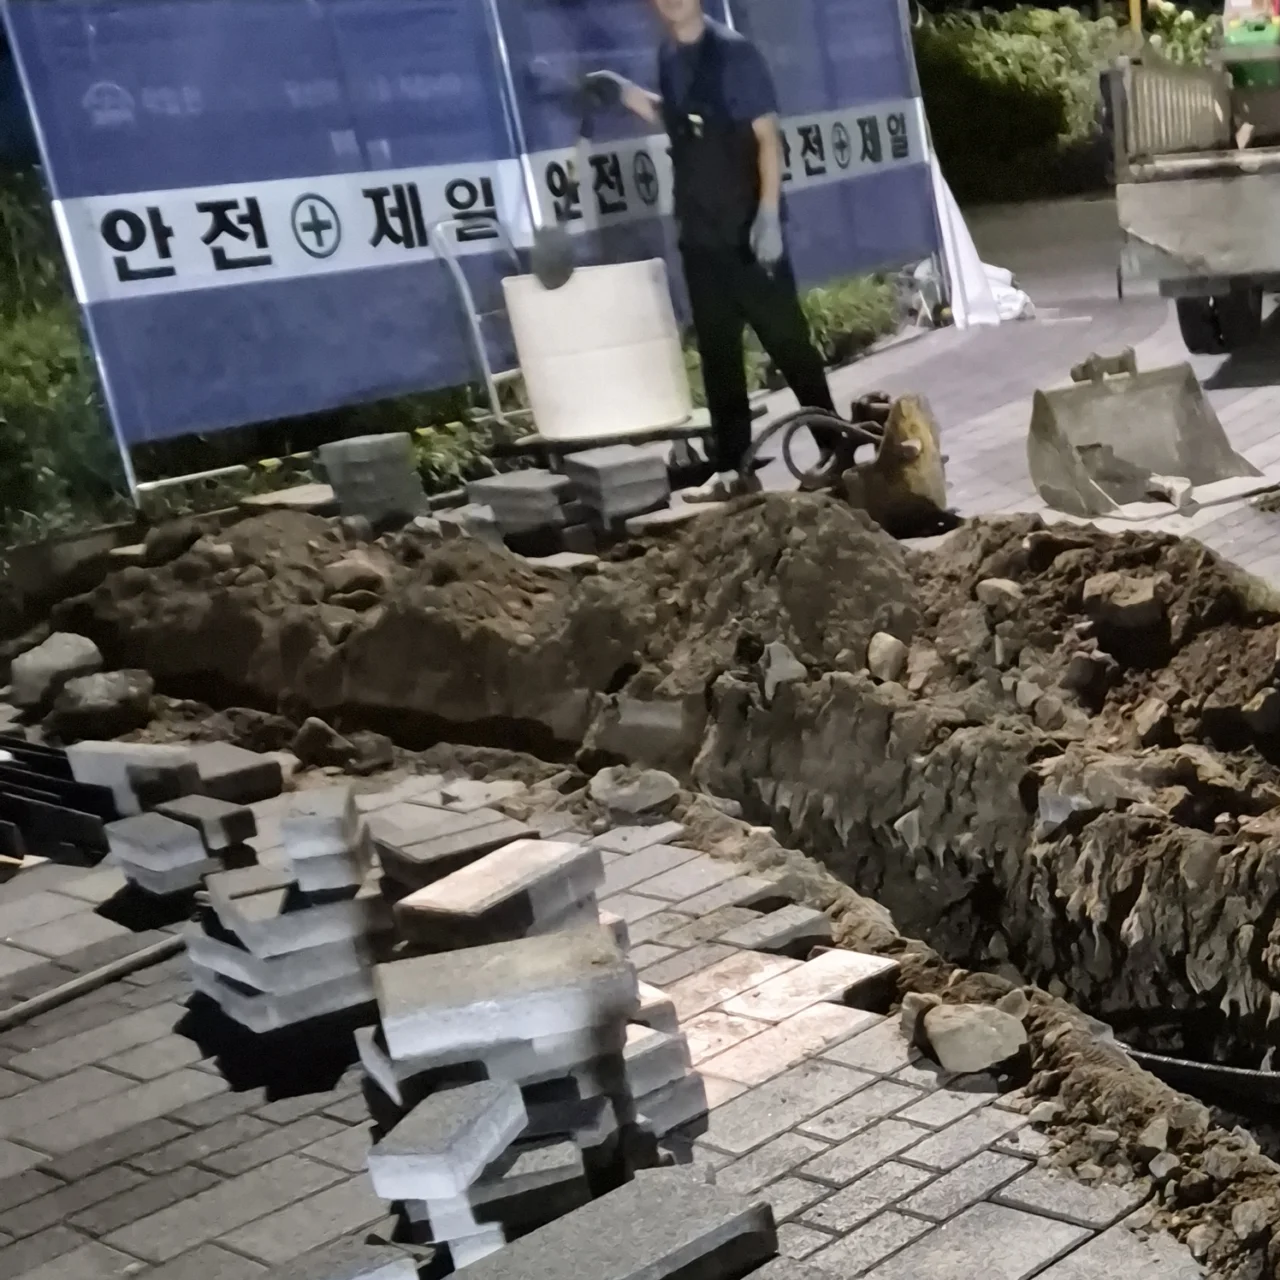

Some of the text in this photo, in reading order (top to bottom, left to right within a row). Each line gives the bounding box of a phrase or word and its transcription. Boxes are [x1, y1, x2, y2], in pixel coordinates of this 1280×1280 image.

[856, 112, 909, 163] 제일
[545, 152, 628, 222] 안전
[100, 176, 500, 282] 안전 제일
